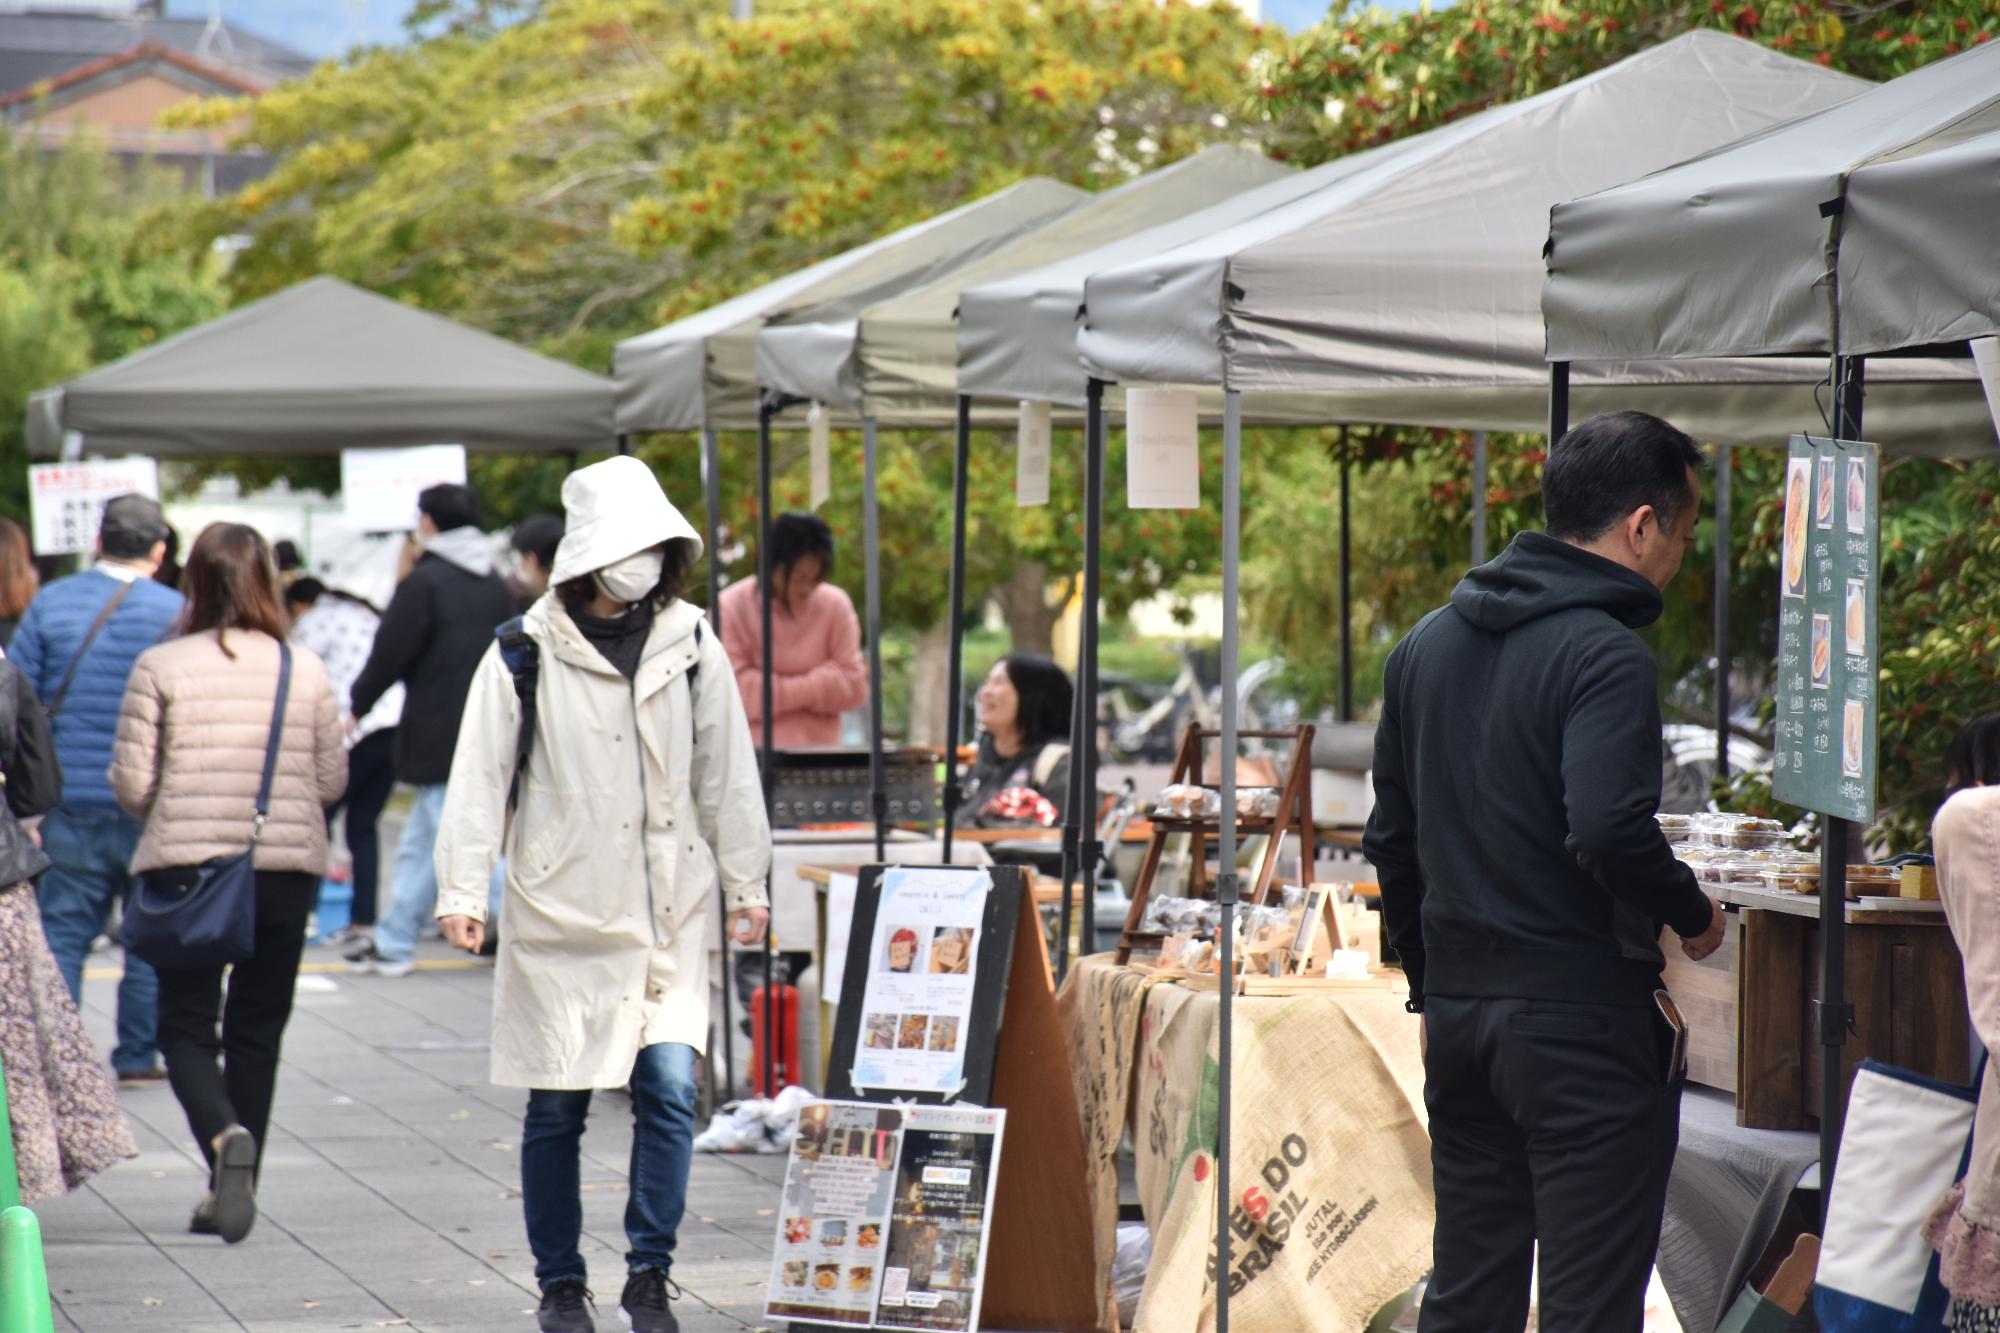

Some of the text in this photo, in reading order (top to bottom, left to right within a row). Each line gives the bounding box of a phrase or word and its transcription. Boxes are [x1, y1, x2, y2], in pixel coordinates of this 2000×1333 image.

[1261, 1133, 1308, 1193] DO
[1227, 1190, 1309, 1298] BRASIL
[1305, 1199, 1338, 1239] JUTAL
